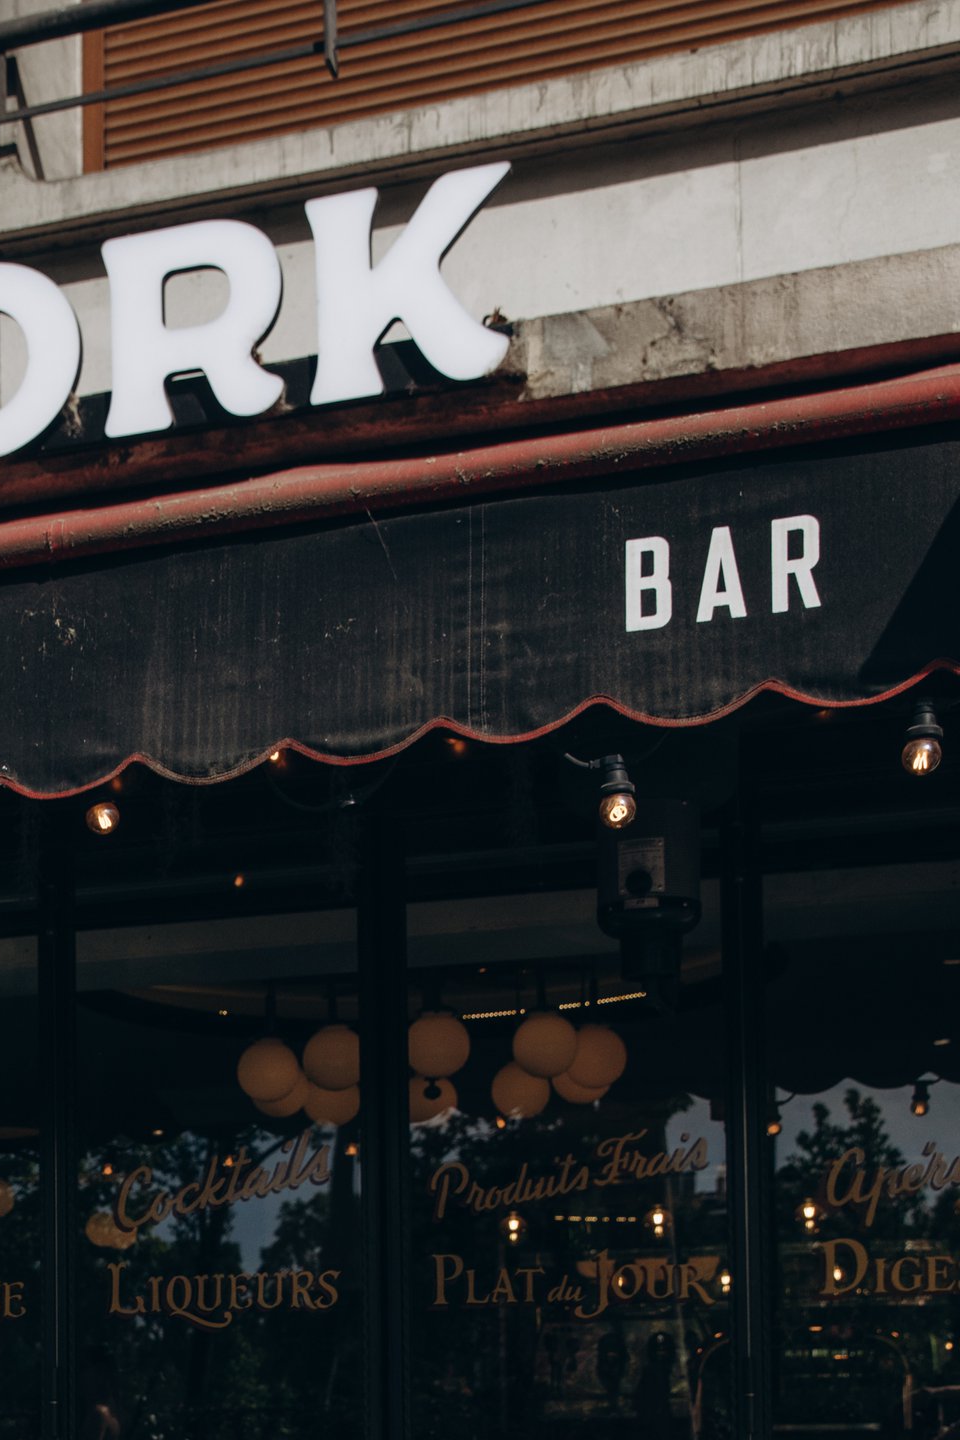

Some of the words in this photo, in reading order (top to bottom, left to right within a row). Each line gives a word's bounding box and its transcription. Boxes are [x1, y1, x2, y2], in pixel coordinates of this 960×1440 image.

[625, 514, 821, 632] BAR
[114, 1128, 330, 1230] Cocktails
[430, 1153, 589, 1219] Produits
[593, 1129, 708, 1186] Frais
[106, 1262, 341, 1328] LIQUEURS
[432, 1253, 545, 1305] PLAT
[547, 1274, 586, 1303] du
[575, 1249, 716, 1319] JOUR
[819, 1238, 960, 1295] DIGE
